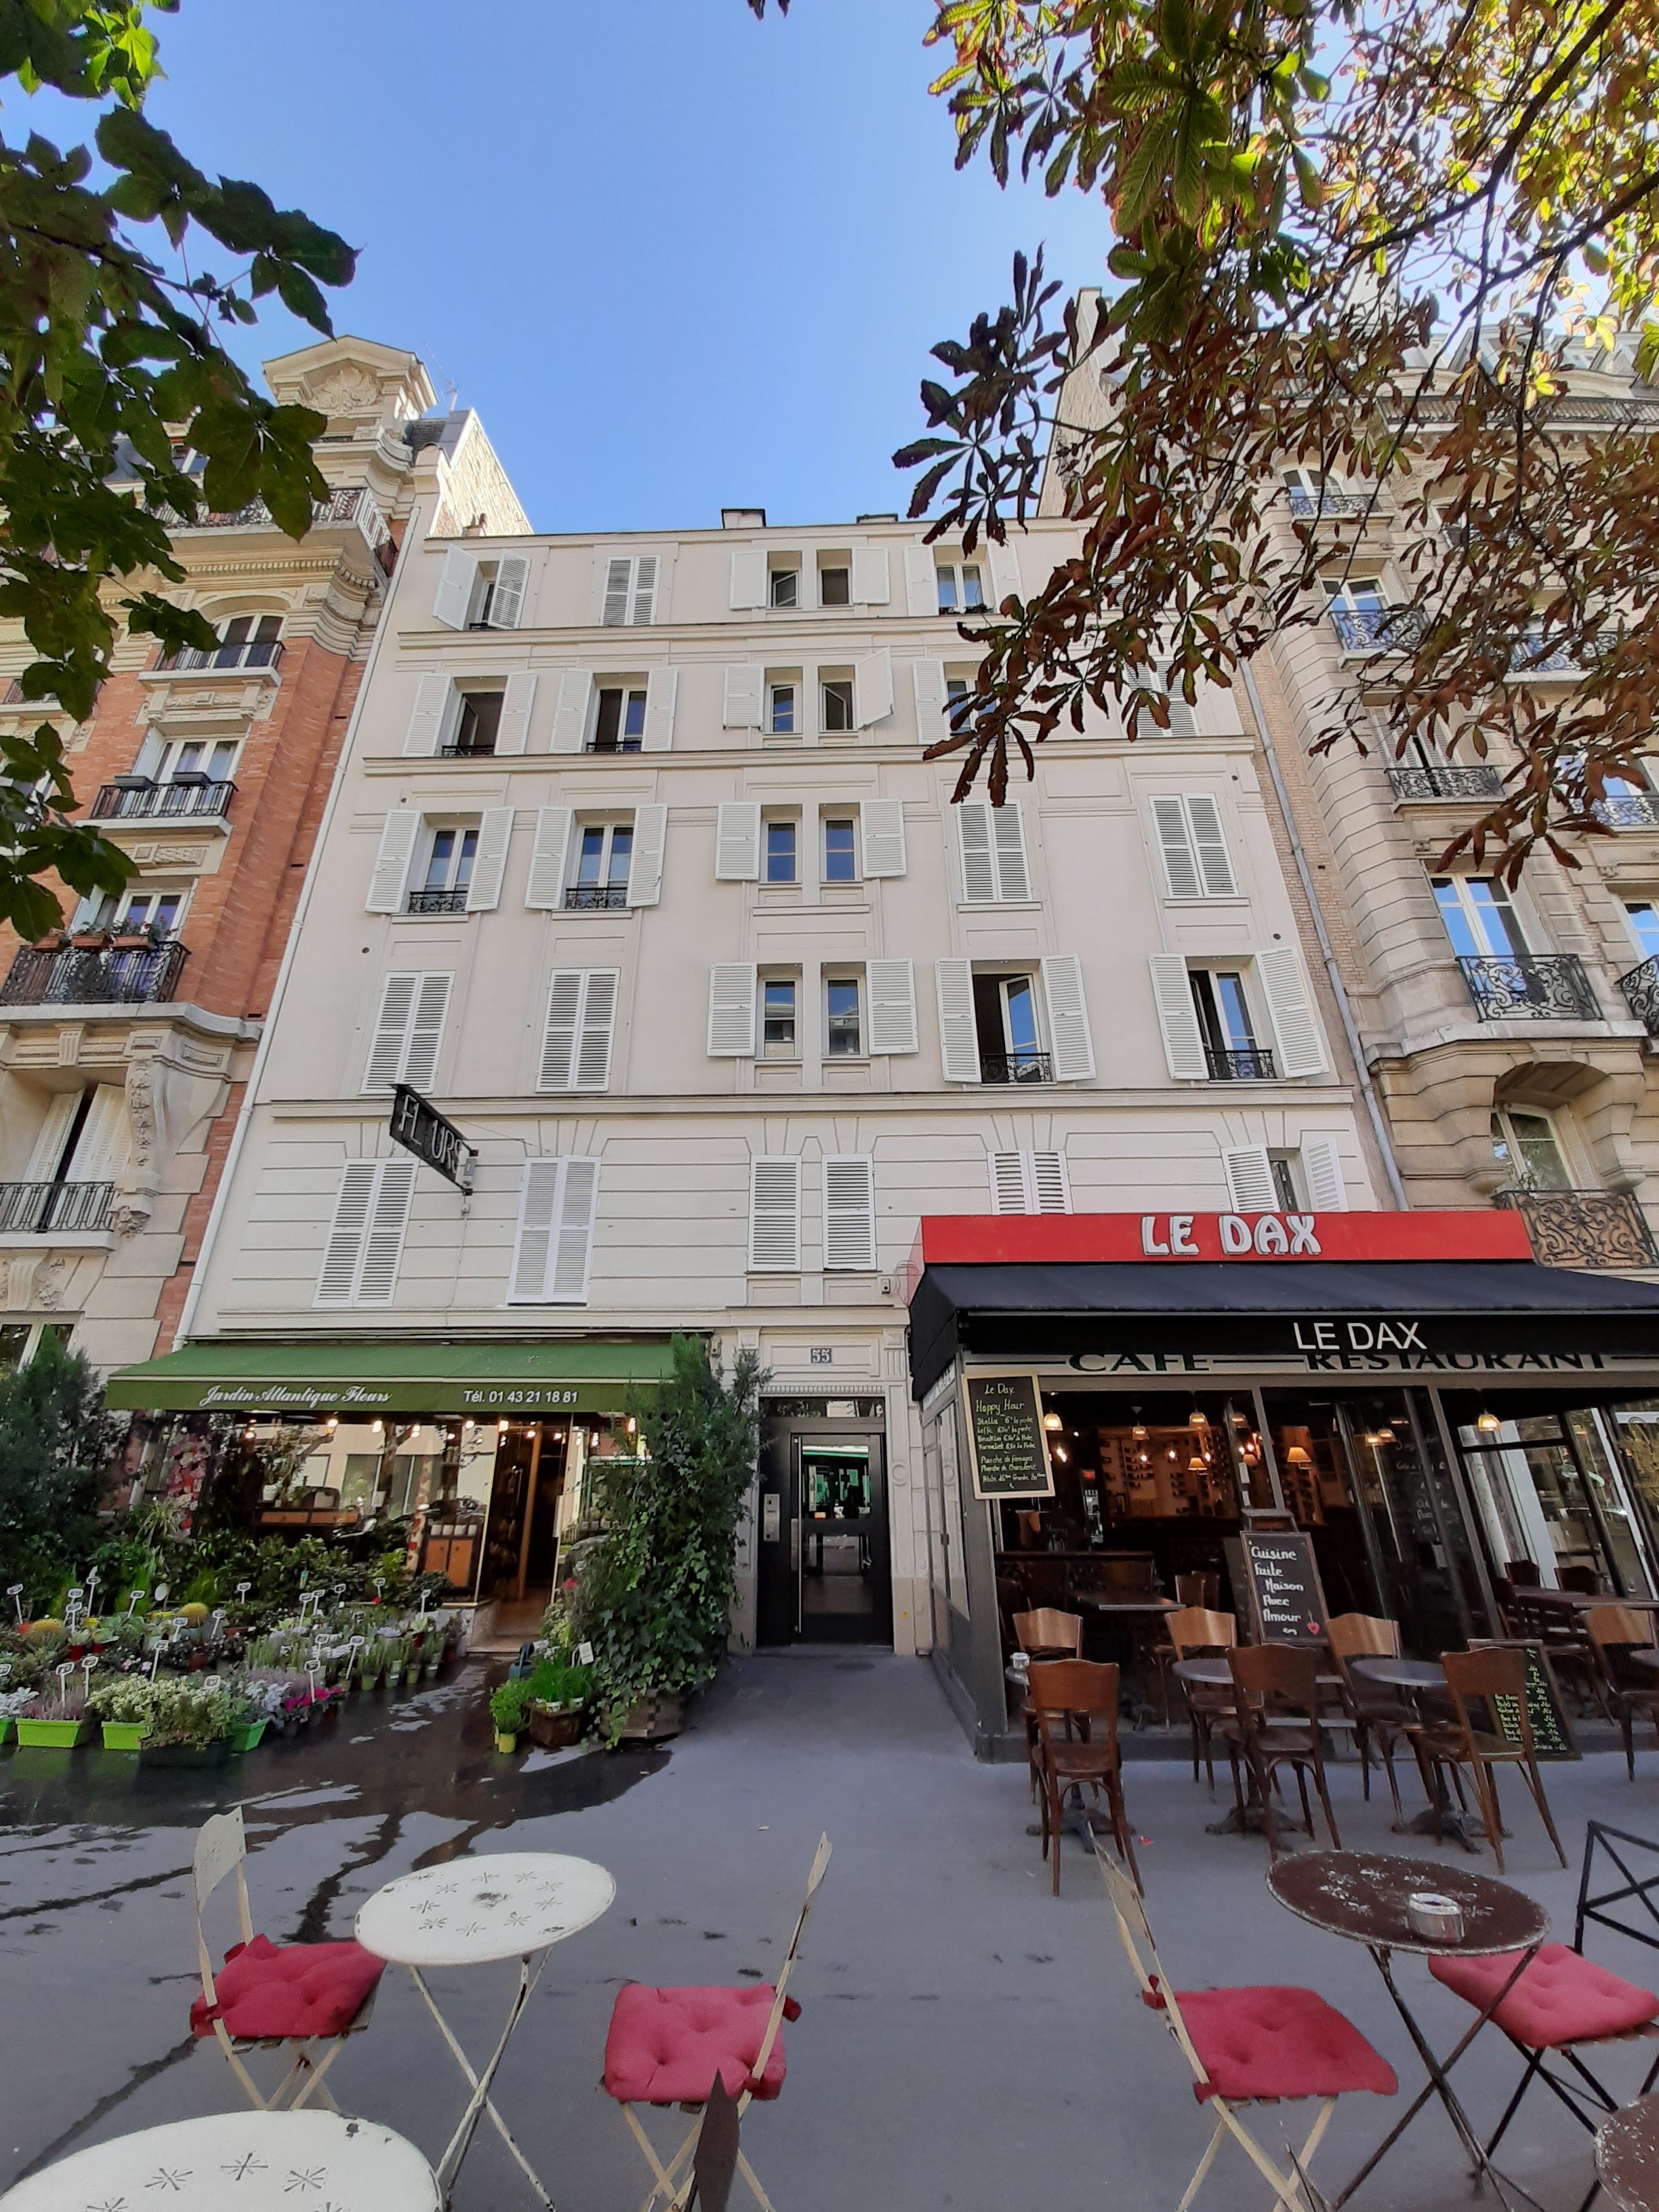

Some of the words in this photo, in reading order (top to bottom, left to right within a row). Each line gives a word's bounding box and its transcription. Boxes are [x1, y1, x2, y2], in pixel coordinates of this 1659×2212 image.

[398, 1094, 464, 1174] FLURS
[1141, 1215, 1200, 1256] LE
[1219, 1214, 1322, 1256] DAX
[1294, 1322, 1340, 1349] LE
[1348, 1322, 1427, 1349] DAX
[812, 1349, 830, 1362] 55
[199, 1385, 255, 1407] Jardin
[341, 1385, 392, 1403] Fleurs
[464, 1390, 485, 1403] Tél.
[489, 1391, 504, 1403] 01
[507, 1391, 524, 1403] 43
[525, 1391, 541, 1403] 21
[546, 1391, 560, 1403] 18
[562, 1391, 578, 1403] 81
[985, 1384, 994, 1395] Le
[976, 1399, 1000, 1415] Happy
[1004, 1399, 1025, 1410] Hour
[977, 1427, 993, 1435] Leffe
[1250, 1546, 1297, 1561] Cuisine
[1254, 1561, 1284, 1576] Faite
[1265, 1578, 1305, 1593] Maison
[1263, 1594, 1290, 1607] Avec
[1263, 1608, 1302, 1622] Amour
